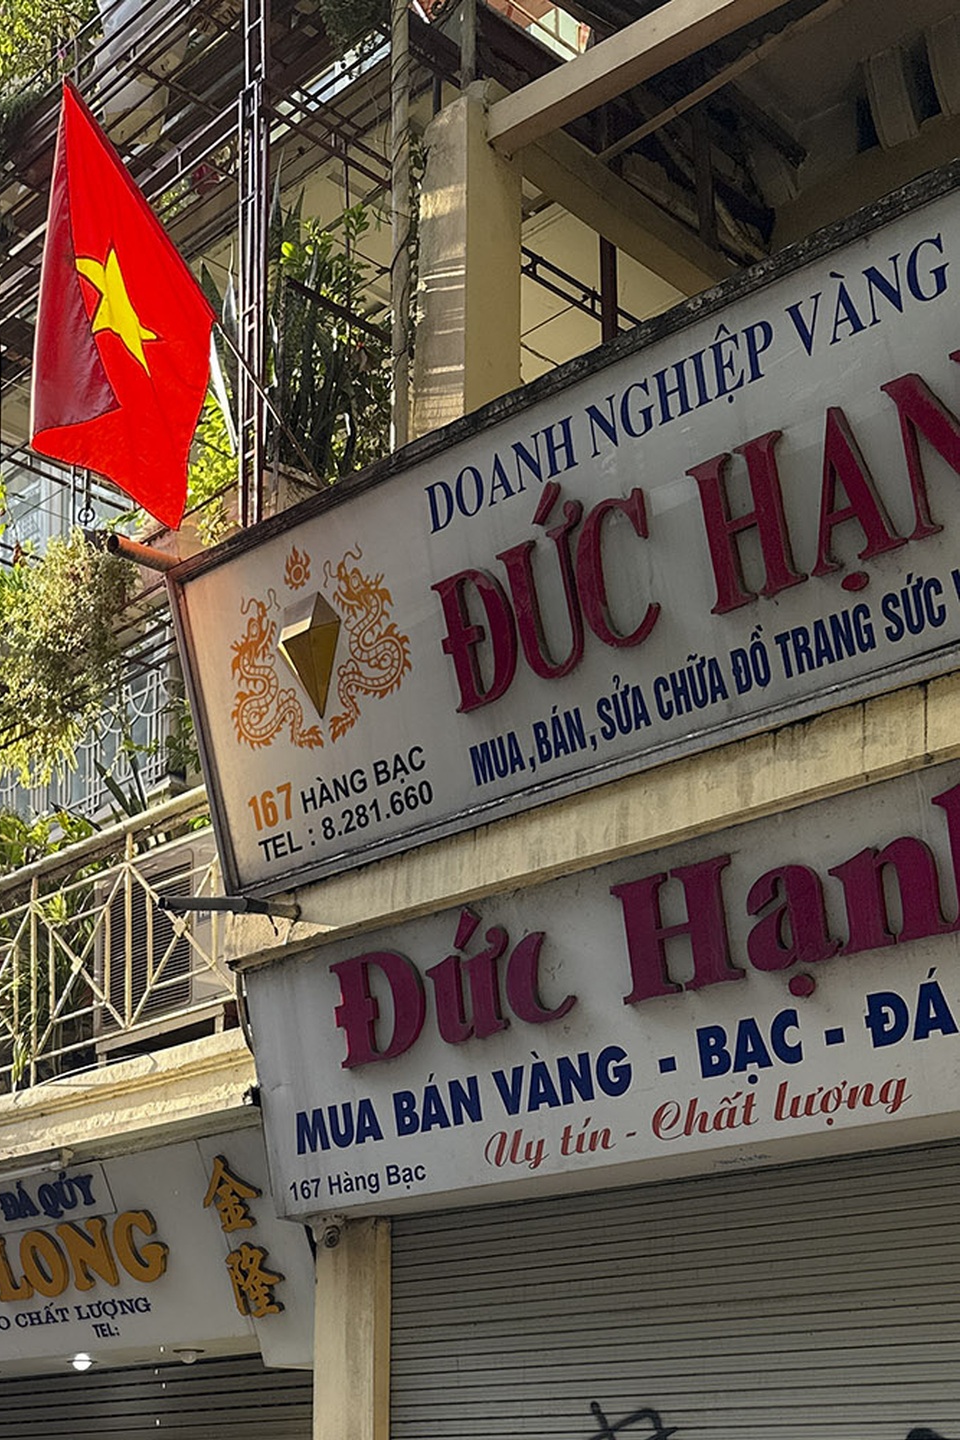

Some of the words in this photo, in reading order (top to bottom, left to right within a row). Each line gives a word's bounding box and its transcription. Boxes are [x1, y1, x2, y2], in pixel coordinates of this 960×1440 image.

[424, 416, 579, 535] DOANH
[584, 324, 775, 460] NGHIỆP
[784, 232, 950, 356] VÀNG
[431, 480, 662, 715] ĐỨC
[596, 674, 652, 741] SỬA
[653, 652, 729, 721] CHỮA
[730, 624, 772, 695] ĐỒ
[774, 603, 877, 679] TRANG
[881, 572, 947, 643] SỨC
[248, 781, 293, 831] 167
[300, 768, 368, 814] HÀNG
[372, 746, 426, 787] BẠC
[321, 780, 433, 840] 8.281.660
[329, 907, 578, 1070] Đức
[295, 1098, 384, 1155] MUA
[392, 1073, 483, 1137] BÁN
[491, 1044, 632, 1116] VÀNG
[696, 1008, 803, 1085] BẠC
[865, 967, 959, 1049] ĐÁ
[484, 1130, 551, 1169] Uy
[560, 1116, 617, 1157] tín
[651, 1090, 760, 1141] Chất
[773, 1076, 913, 1126] lượng
[289, 1178, 321, 1201] 167
[327, 1168, 381, 1198] Hàng
[385, 1160, 427, 1191] Bạc
[14, 1301, 70, 1328] CHẤT
[73, 1296, 152, 1321] LƯỢNG
[91, 1321, 121, 1338] TEL:
